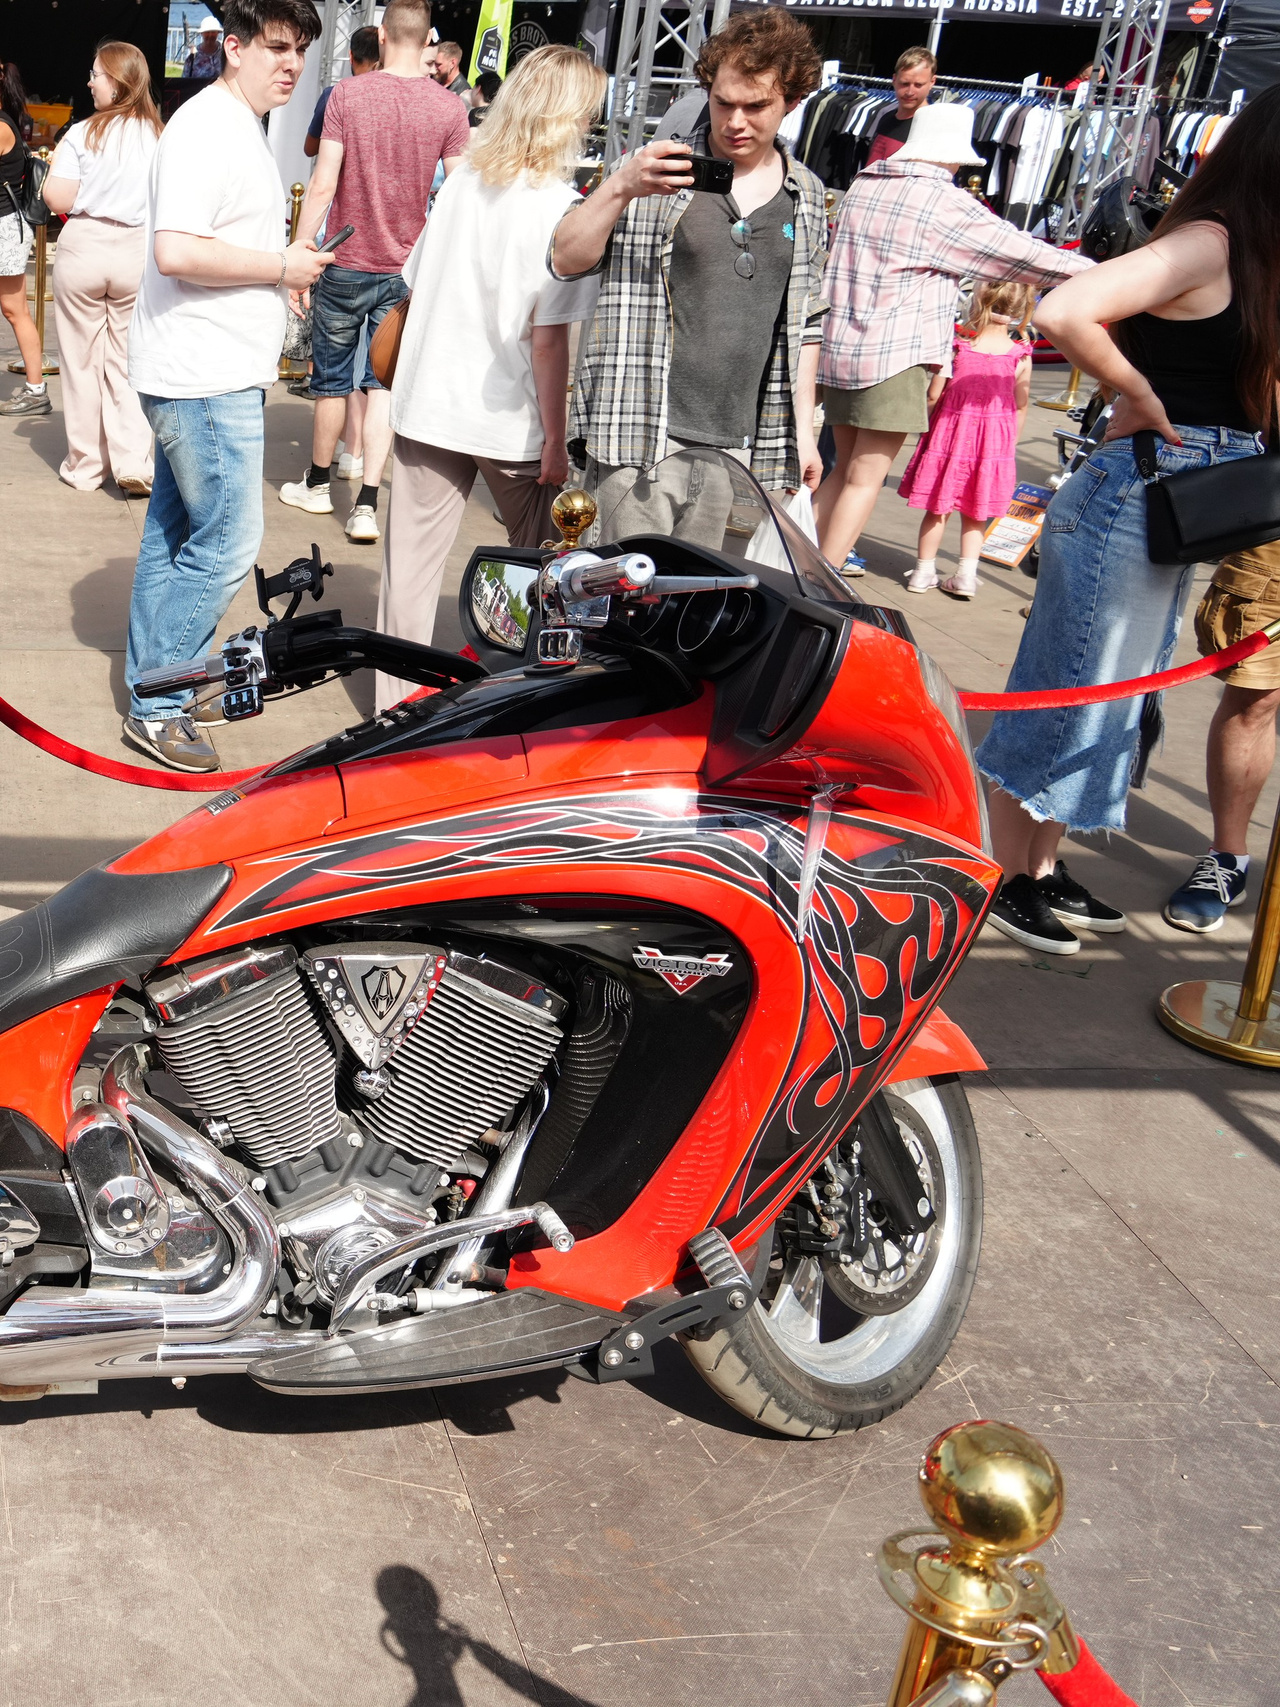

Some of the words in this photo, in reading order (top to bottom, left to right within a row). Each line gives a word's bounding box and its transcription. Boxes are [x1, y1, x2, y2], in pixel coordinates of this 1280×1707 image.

[1060, 0, 1102, 18] EST.
[1112, 0, 1163, 20] 21
[1006, 503, 1038, 521] CUSTOM
[638, 957, 727, 974] VICTORY
[858, 1191, 866, 1241] VICTORY
